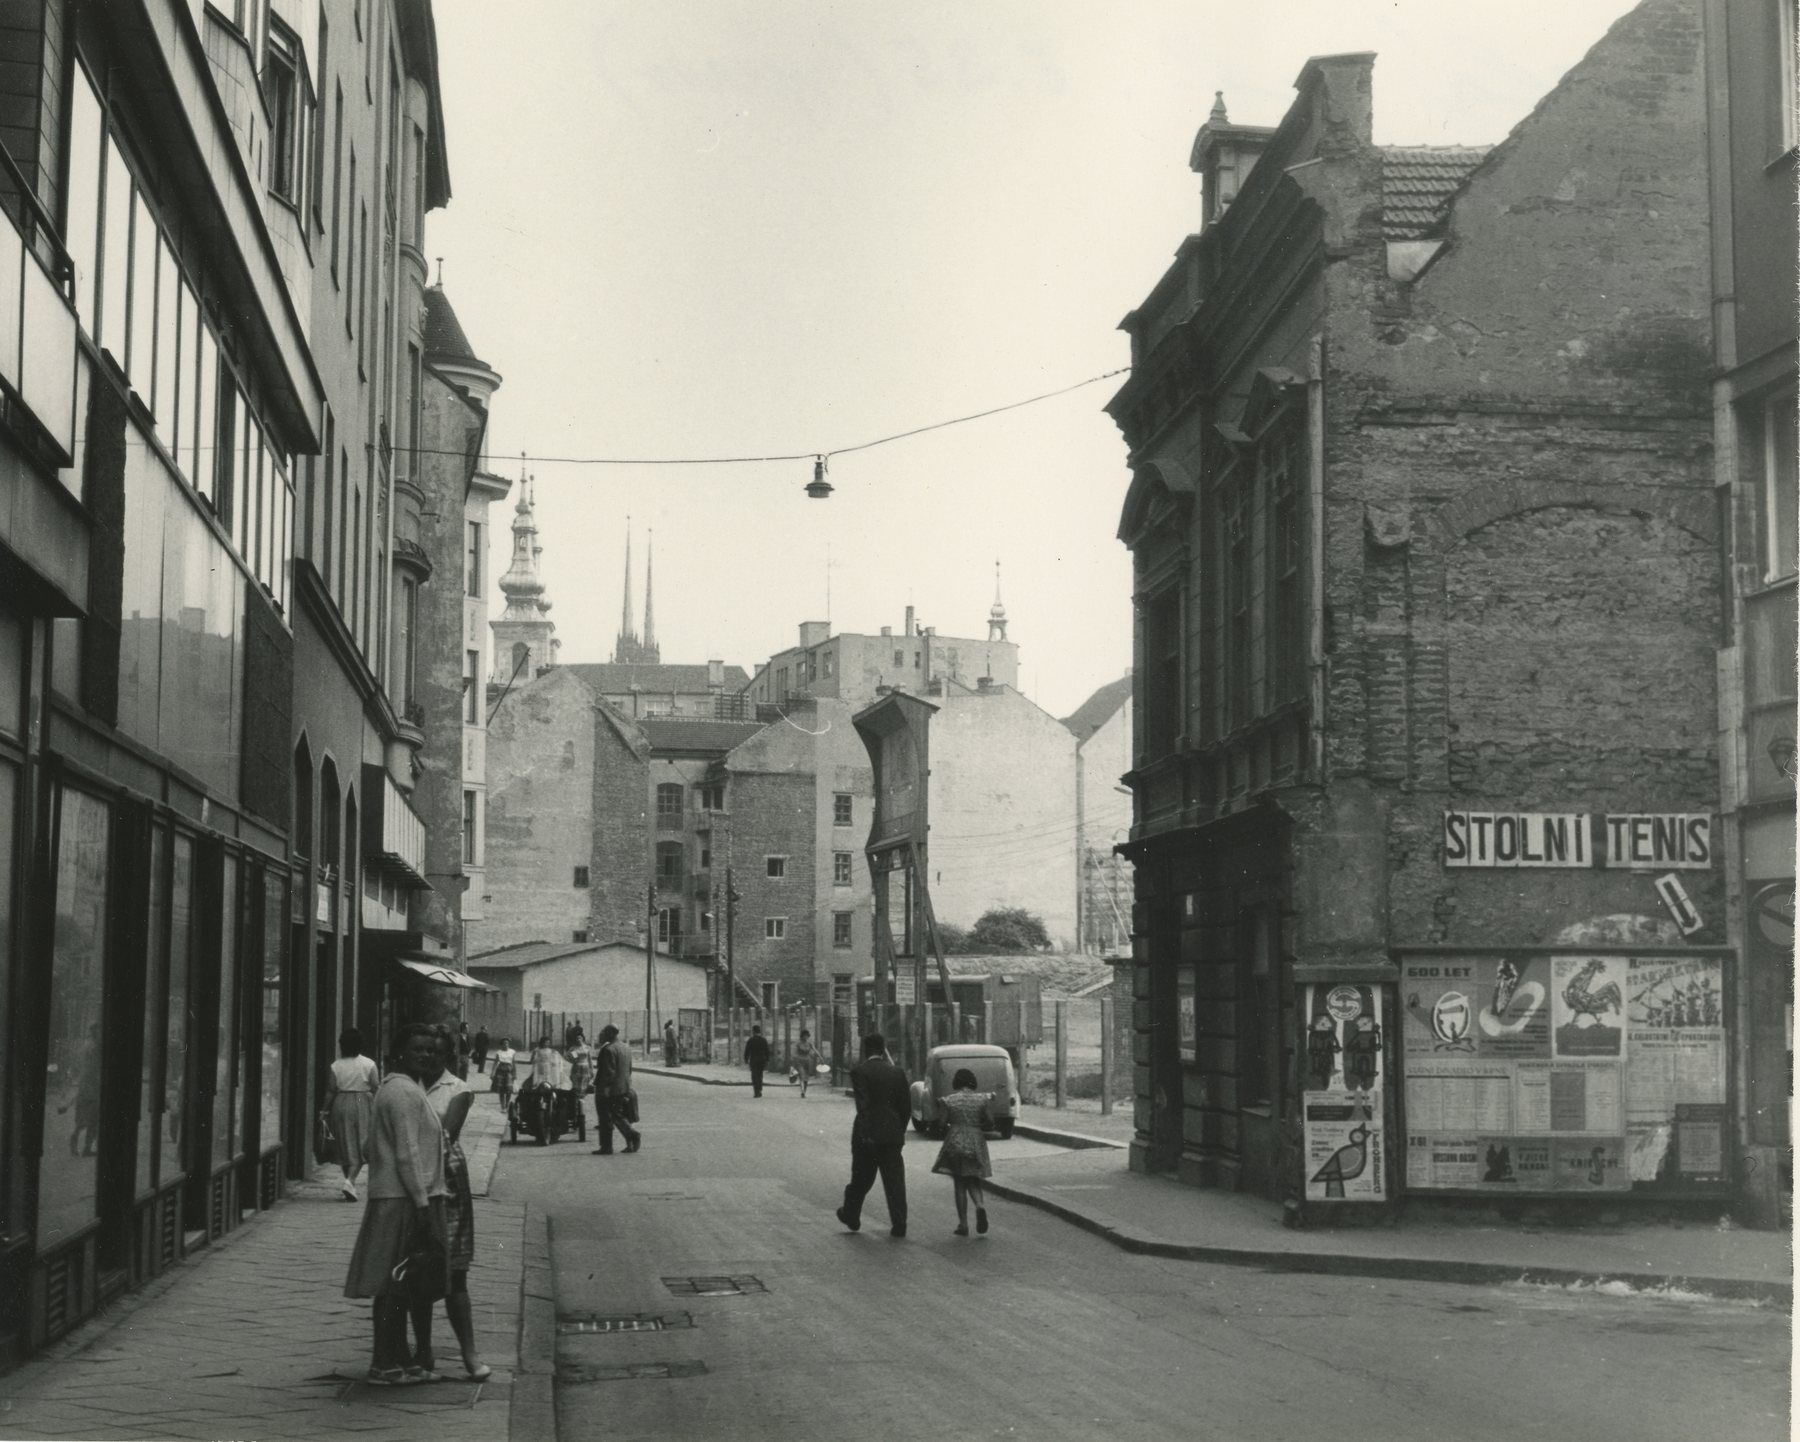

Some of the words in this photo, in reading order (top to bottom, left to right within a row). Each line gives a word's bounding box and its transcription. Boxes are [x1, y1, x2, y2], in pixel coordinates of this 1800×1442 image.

[1446, 813, 1584, 863] STOLNÍ
[1607, 816, 1710, 863] TENIS
[1407, 967, 1439, 978] 600
[1444, 967, 1472, 978] LET
